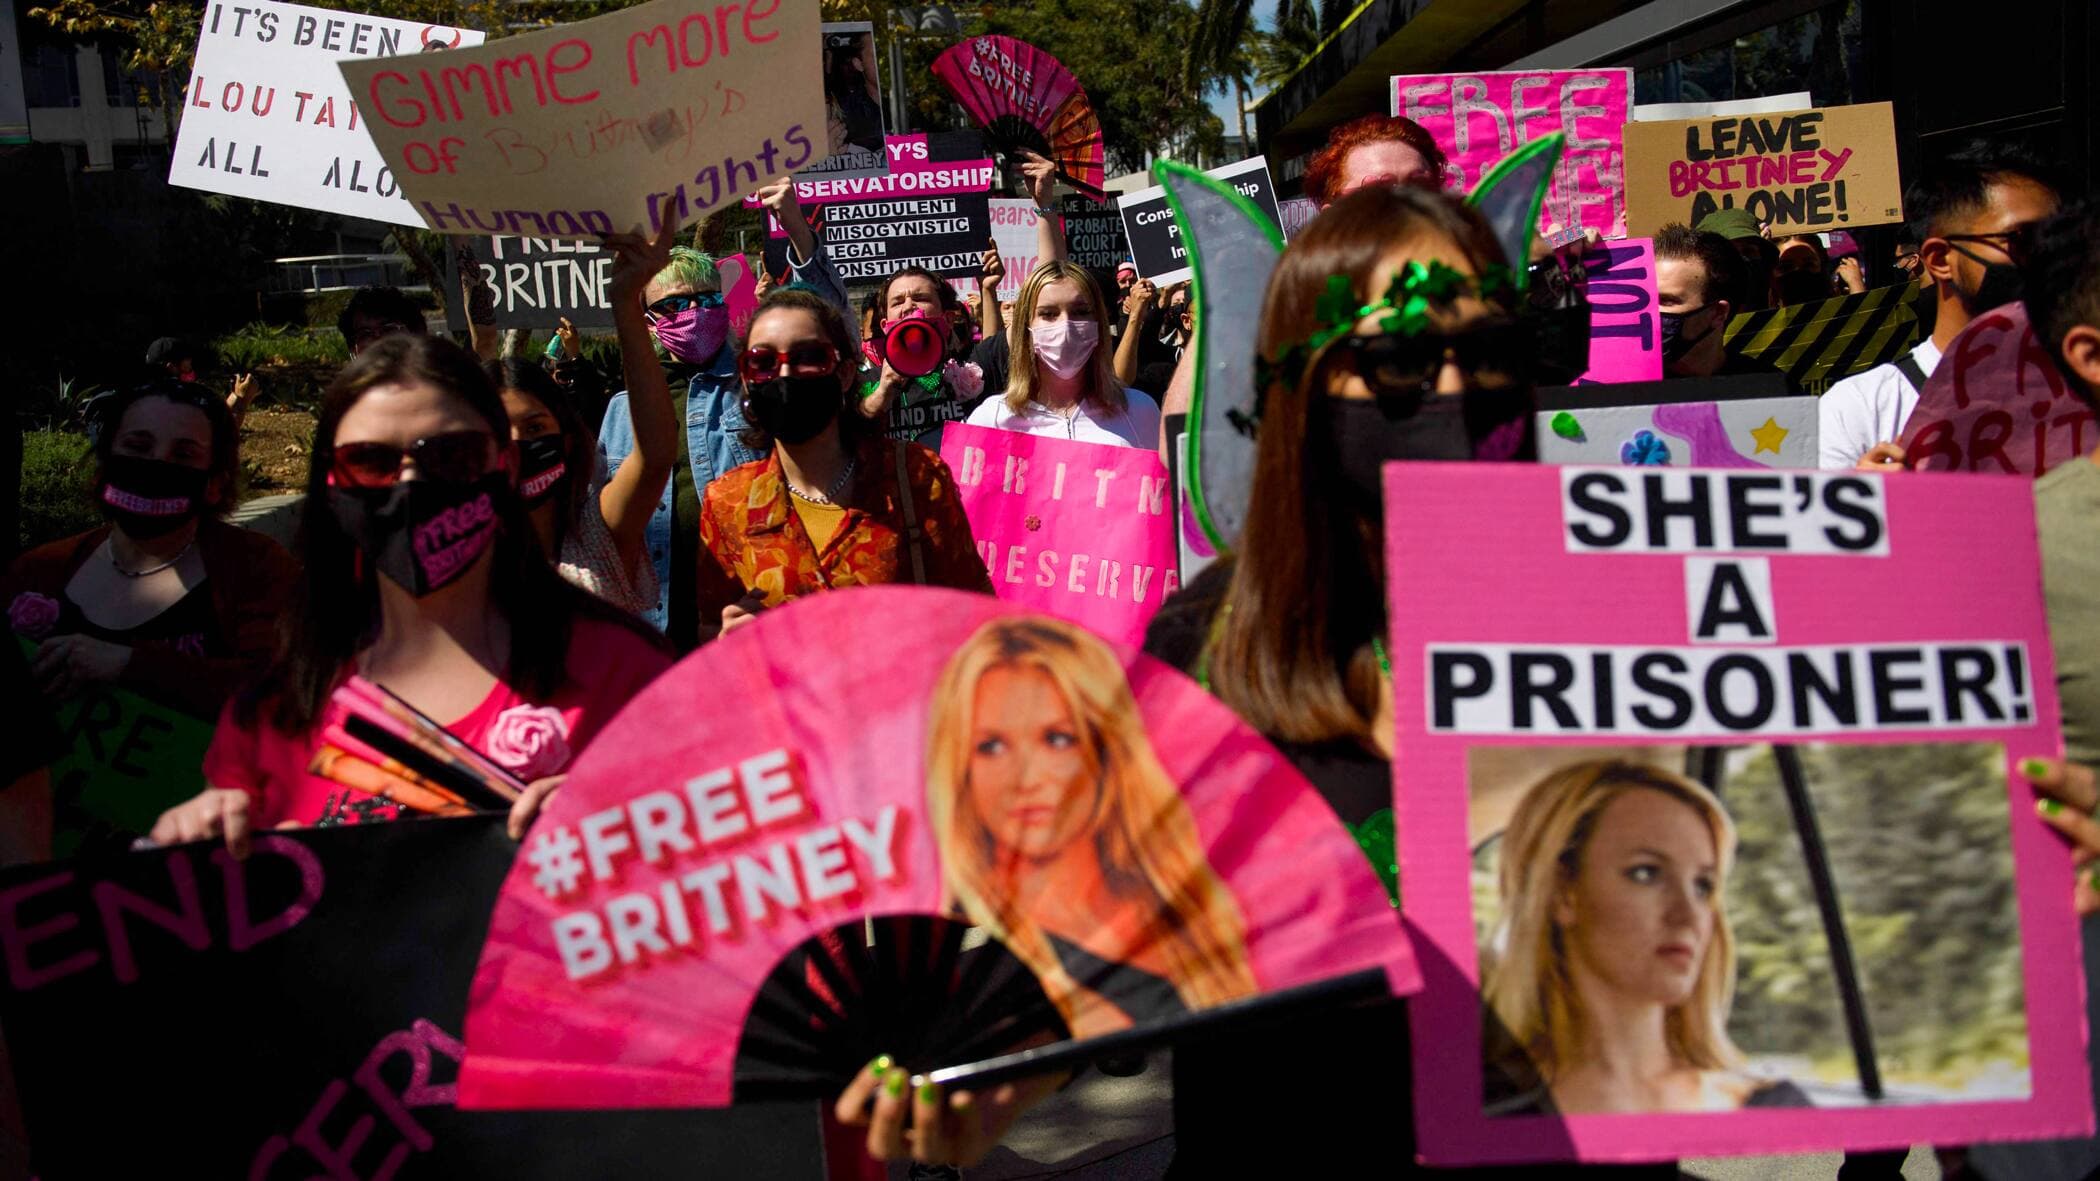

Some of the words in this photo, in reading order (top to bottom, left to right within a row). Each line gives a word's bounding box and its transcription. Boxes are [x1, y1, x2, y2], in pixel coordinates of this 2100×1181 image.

[210, 4, 279, 43] IT'S
[293, 15, 402, 57] BEEN
[969, 56, 1049, 118] BRITNEY
[975, 37, 1034, 87] #FREE
[192, 76, 275, 117] LOU
[295, 91, 358, 131] TAY
[1404, 77, 1612, 154] FREE
[888, 142, 928, 161] Y'S
[1686, 112, 1824, 162] LEAVE
[198, 137, 269, 178] ALL
[322, 156, 407, 200] ALO
[793, 167, 993, 199] SERVATORSHIP
[1669, 148, 1853, 198] BRITNEY
[827, 199, 954, 221] FRAUDULENT
[828, 218, 968, 241] MISOGYNISTIC
[988, 205, 1038, 228] pears
[1063, 199, 1080, 213] WE
[1085, 197, 1119, 213] DEMAN
[1065, 217, 1123, 235] PROBATE
[825, 243, 886, 259] LEGAL
[1072, 233, 1118, 251] COURT
[479, 257, 613, 312] BRITNE
[959, 446, 1168, 516] BRITN
[1566, 473, 1883, 552] SHE'S
[977, 540, 1180, 604] DESERVE
[1695, 562, 1769, 638] A
[1430, 647, 2034, 731] PRISONER!
[527, 748, 805, 899] #FREE
[0, 835, 326, 991] END
[551, 804, 900, 982] BRITNEY
